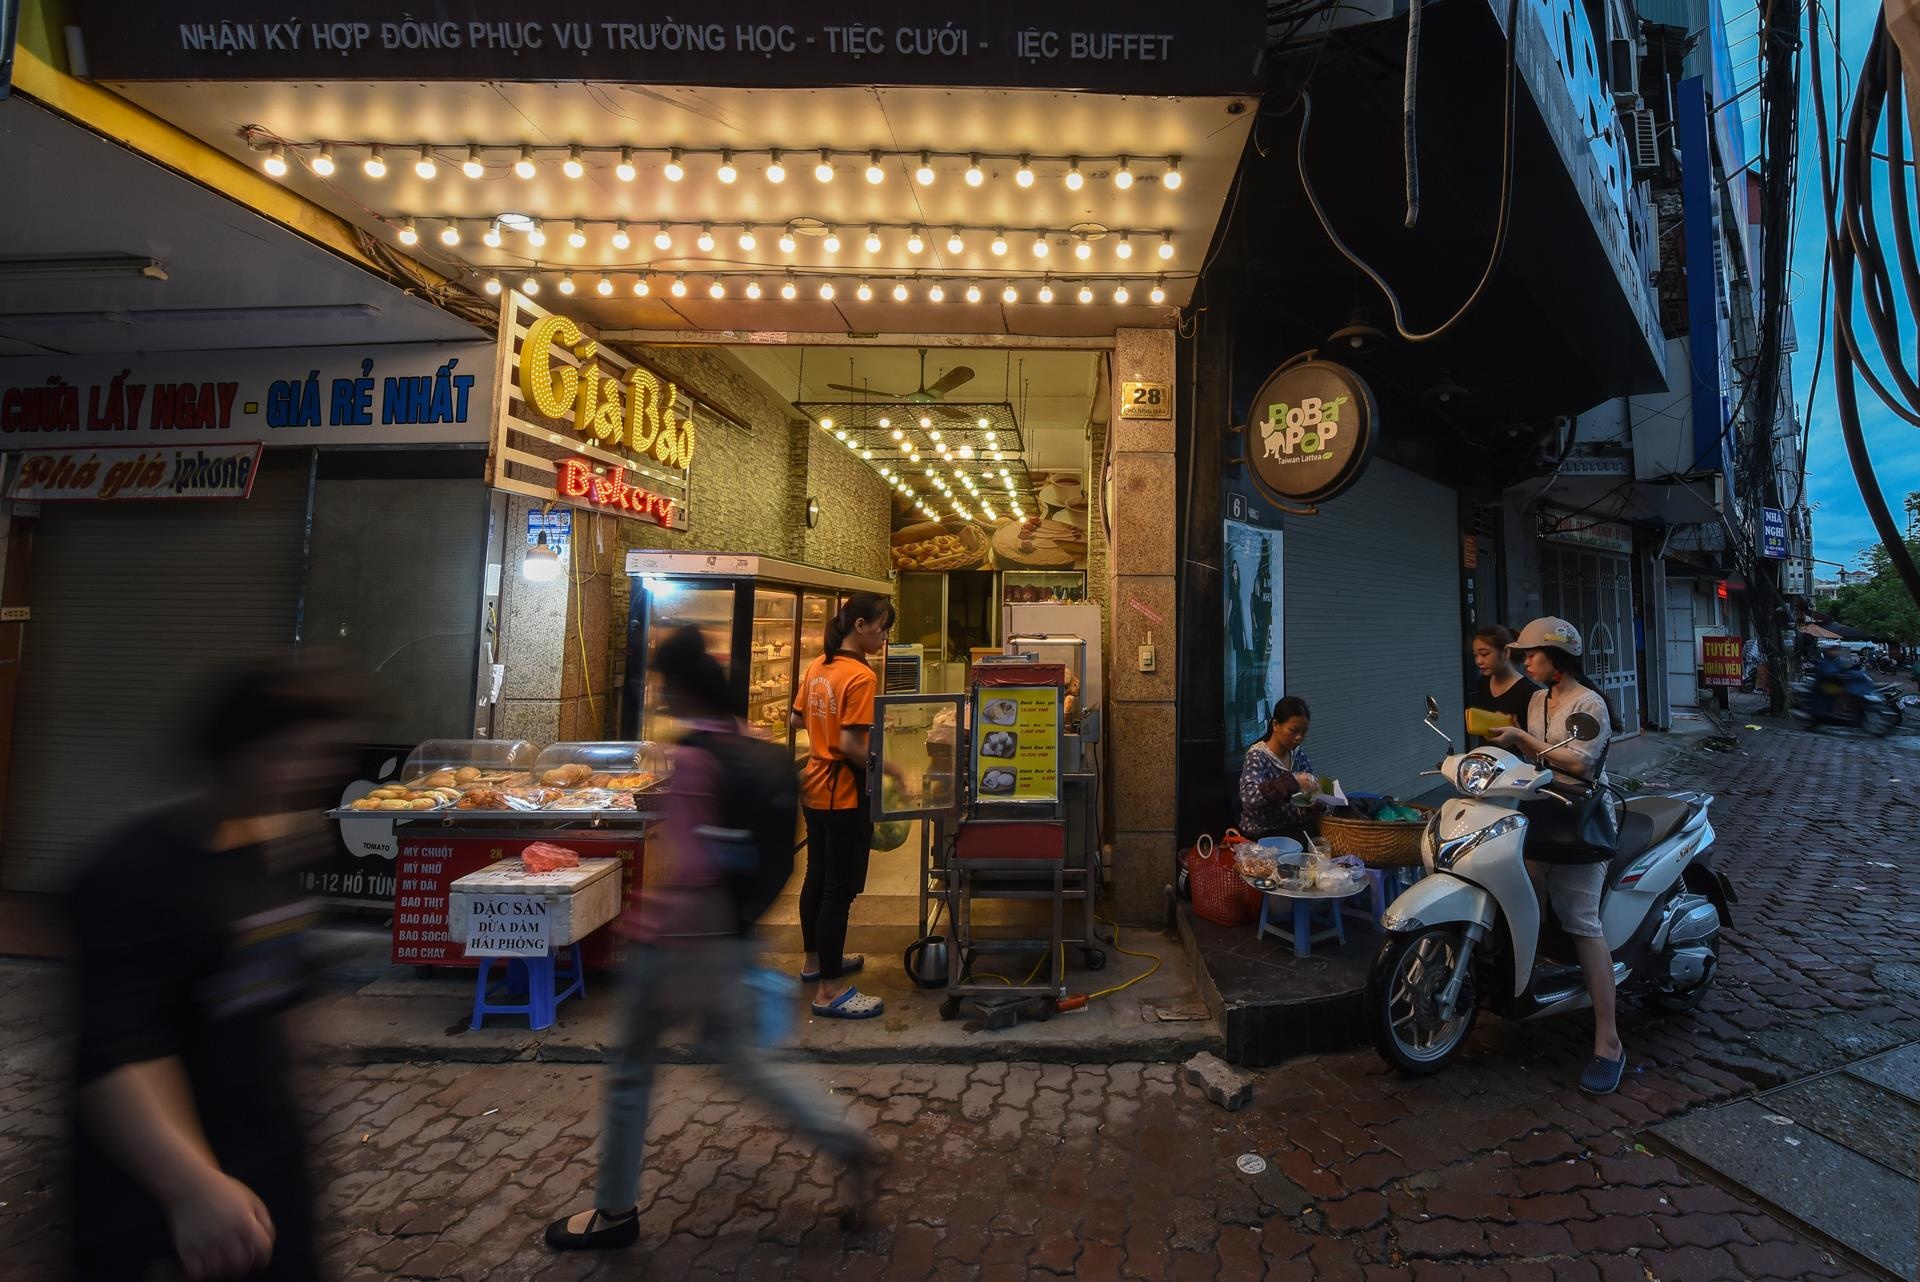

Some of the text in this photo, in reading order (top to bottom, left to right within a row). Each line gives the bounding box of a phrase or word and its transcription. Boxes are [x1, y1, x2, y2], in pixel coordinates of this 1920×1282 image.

[179, 19, 257, 56] NHẬN
[264, 16, 301, 50] KÝ
[312, 22, 370, 57] HỢP
[381, 12, 462, 50] ĐỒNG
[469, 21, 543, 56] PHỤC
[552, 22, 593, 56] VỤ
[600, 16, 726, 51] TRƯỜNG
[736, 24, 796, 59] HỌC
[824, 22, 884, 60] TIỆC
[895, 21, 968, 57] CƯỚI
[1070, 32, 1174, 61] BUFFET
[519, 315, 624, 445] Gia
[2, 375, 80, 433] CHỮA
[87, 369, 147, 431] LẤY
[151, 382, 239, 430] NGAY
[266, 370, 322, 428] GIÁ
[330, 358, 375, 426] RẺ
[382, 358, 475, 425] NHẤT
[1133, 388, 1161, 405] 28
[1278, 454, 1322, 465] Taiwan Lattea
[98, 452, 168, 498] giá
[169, 451, 252, 493] iphone
[1233, 498, 1241, 518] 6
[1765, 510, 1783, 523] NHÀ
[1765, 524, 1784, 537] NGHỈ
[1705, 638, 1739, 657] TUYỂN
[1704, 661, 1741, 675] NHÂN VIÊN
[363, 842, 390, 852] TOMATO
[490, 849, 502, 860] 2K
[342, 868, 363, 894] HỒ
[367, 872, 397, 896] TÙN
[401, 897, 444, 910] BAO THỊT
[473, 898, 546, 918] ĐẶC SẢN
[400, 914, 419, 924] BAO
[423, 912, 442, 926] ĐẬU
[479, 919, 506, 932] DỪA
[399, 931, 418, 941] BAO
[422, 931, 449, 942] SOCO
[471, 935, 545, 949] HẢI PHÒNG
[398, 947, 417, 958] BAO
[420, 948, 446, 958] CHAY
